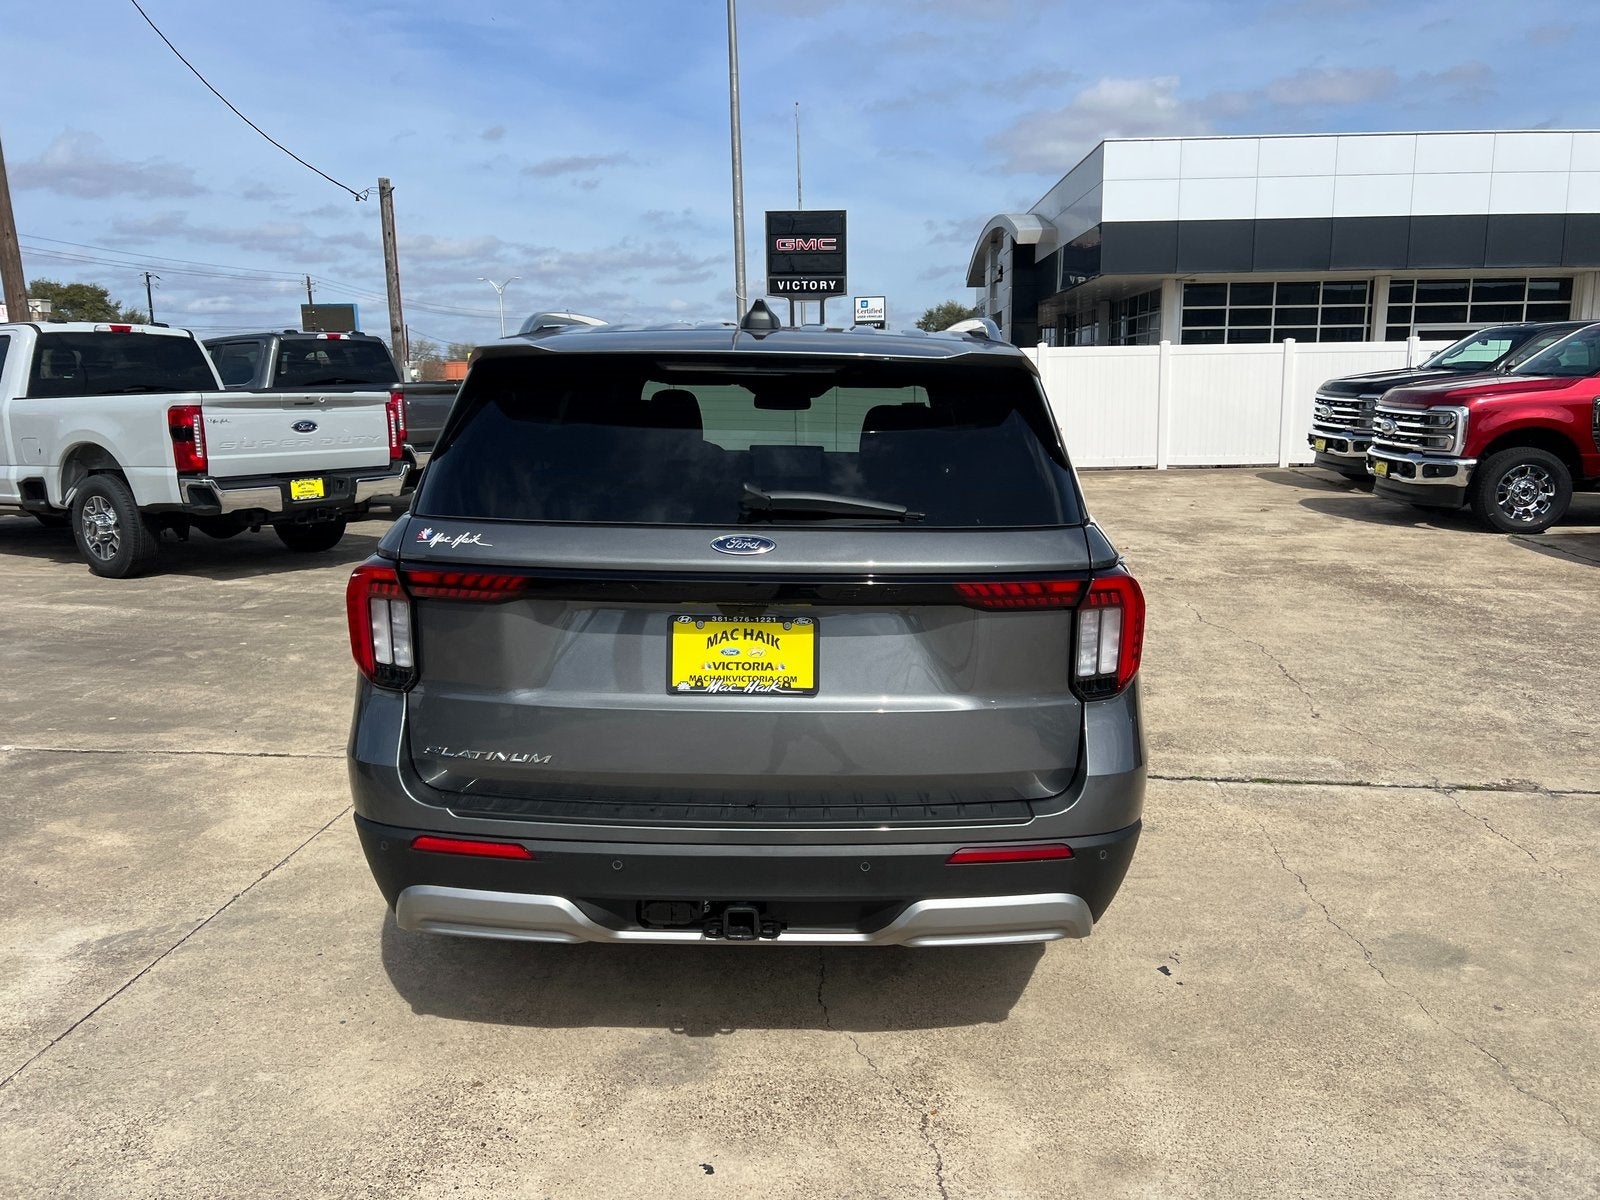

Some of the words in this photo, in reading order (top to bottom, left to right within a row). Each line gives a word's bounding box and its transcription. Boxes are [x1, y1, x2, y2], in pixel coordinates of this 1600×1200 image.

[776, 238, 837, 251] GMC
[777, 280, 837, 291] VICTORY
[219, 437, 314, 450] SUPER
[320, 434, 382, 447] DUTY
[429, 532, 453, 548] Mac
[711, 615, 777, 623] 361-576-1221
[706, 628, 740, 649] MAC
[743, 628, 781, 650] HAIK
[712, 661, 775, 671] VICTORIA
[705, 678, 743, 693] Mac
[743, 678, 784, 694] Haik
[423, 746, 553, 764] PLATINUM
